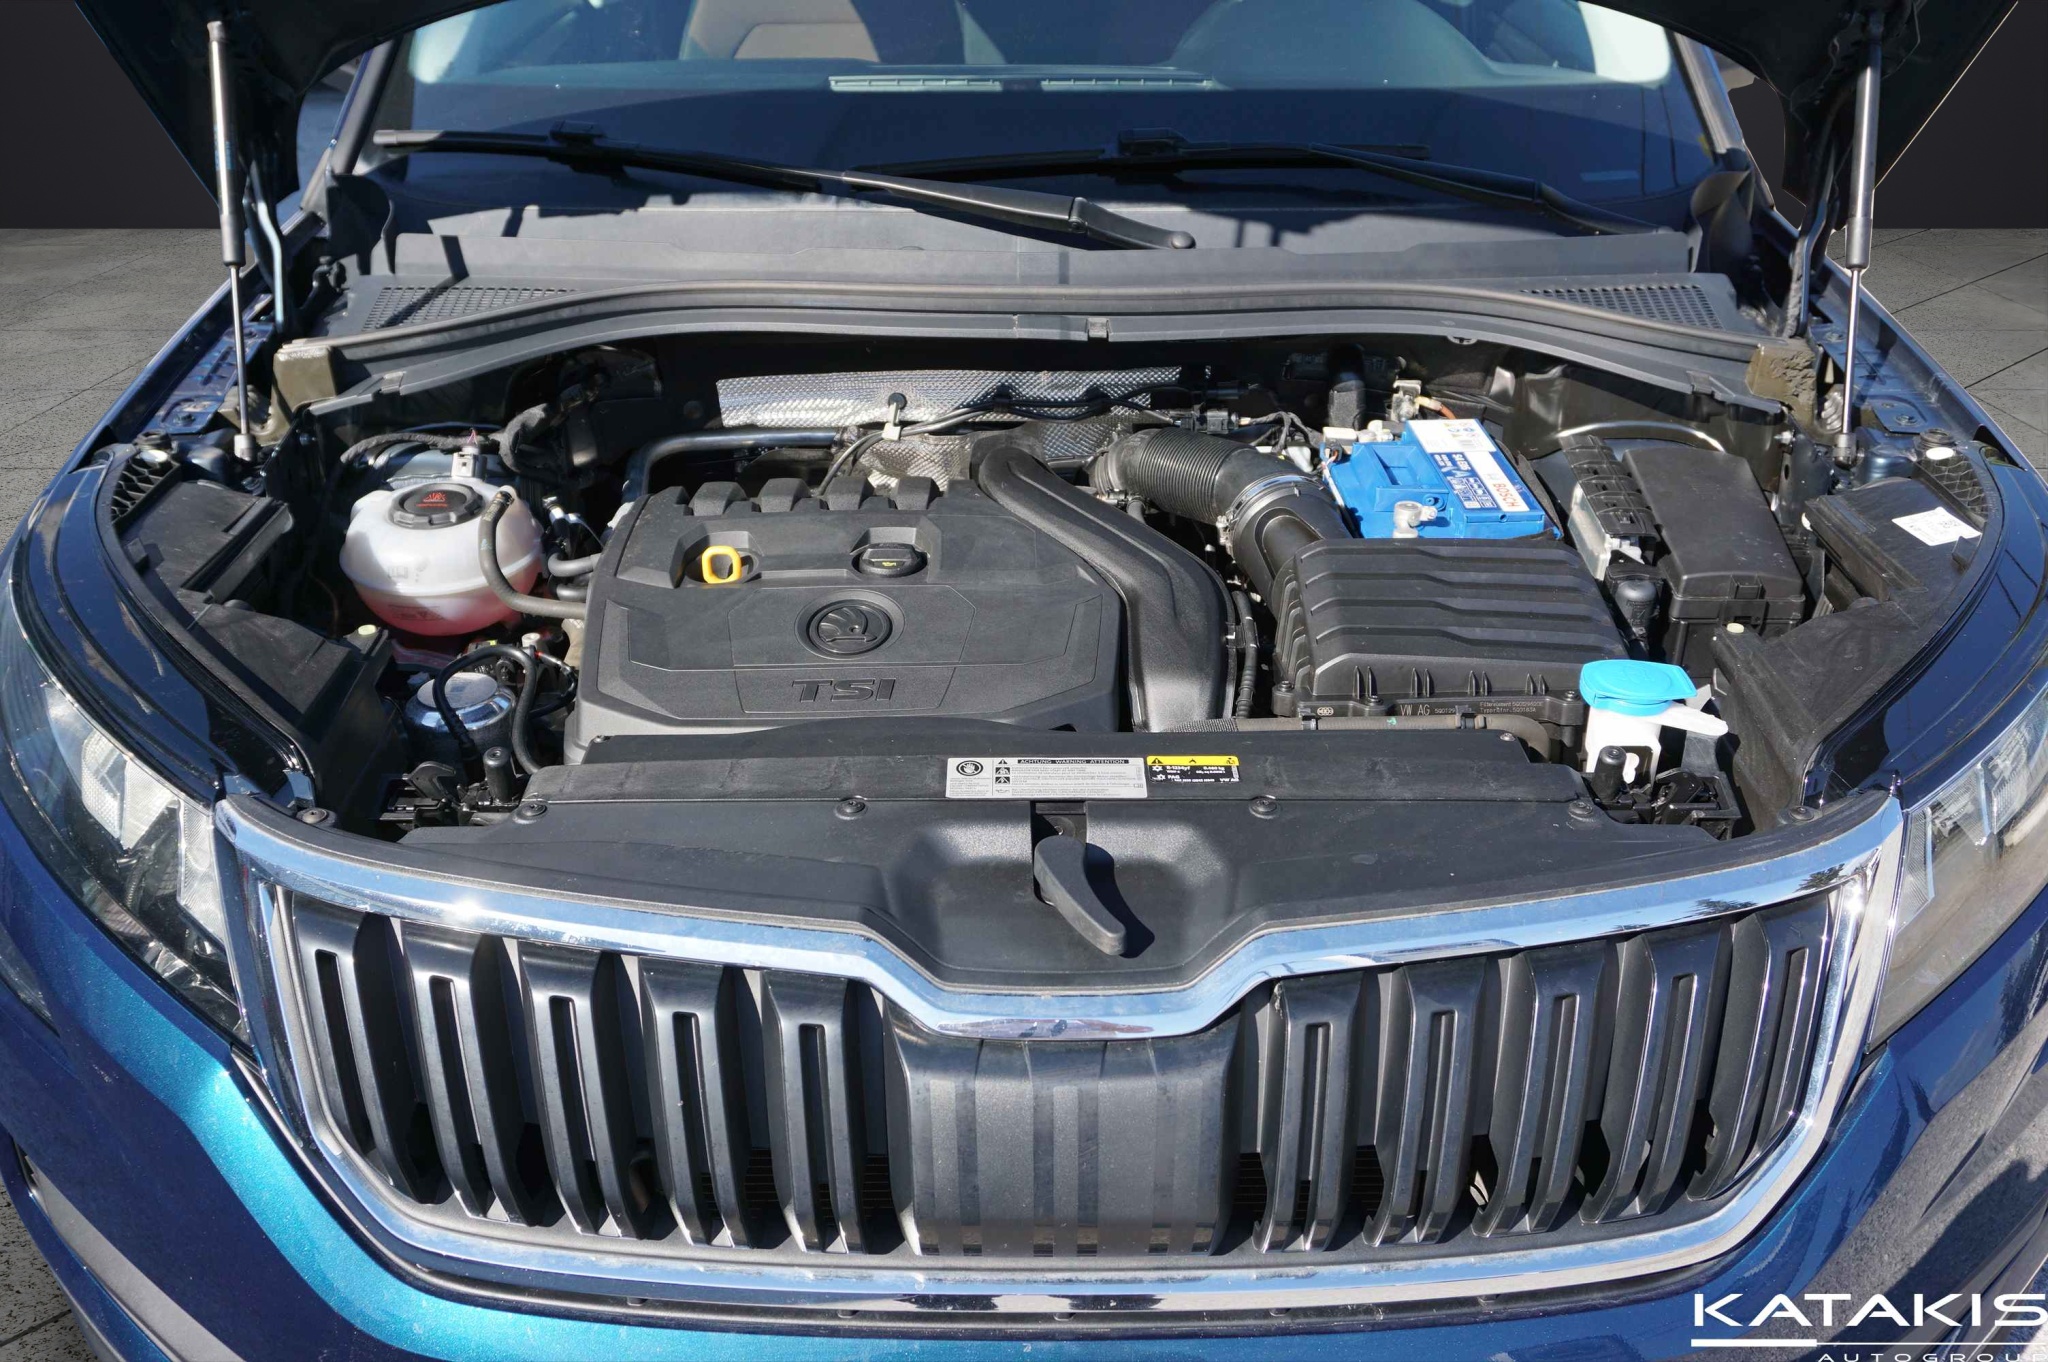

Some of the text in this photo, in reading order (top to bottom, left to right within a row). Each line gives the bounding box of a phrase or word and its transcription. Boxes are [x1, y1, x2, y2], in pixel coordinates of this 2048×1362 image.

[1493, 483, 1521, 507] BOSCH
[791, 678, 897, 702] TSI
[1400, 704, 1413, 716] VW
[1418, 704, 1430, 716] AG
